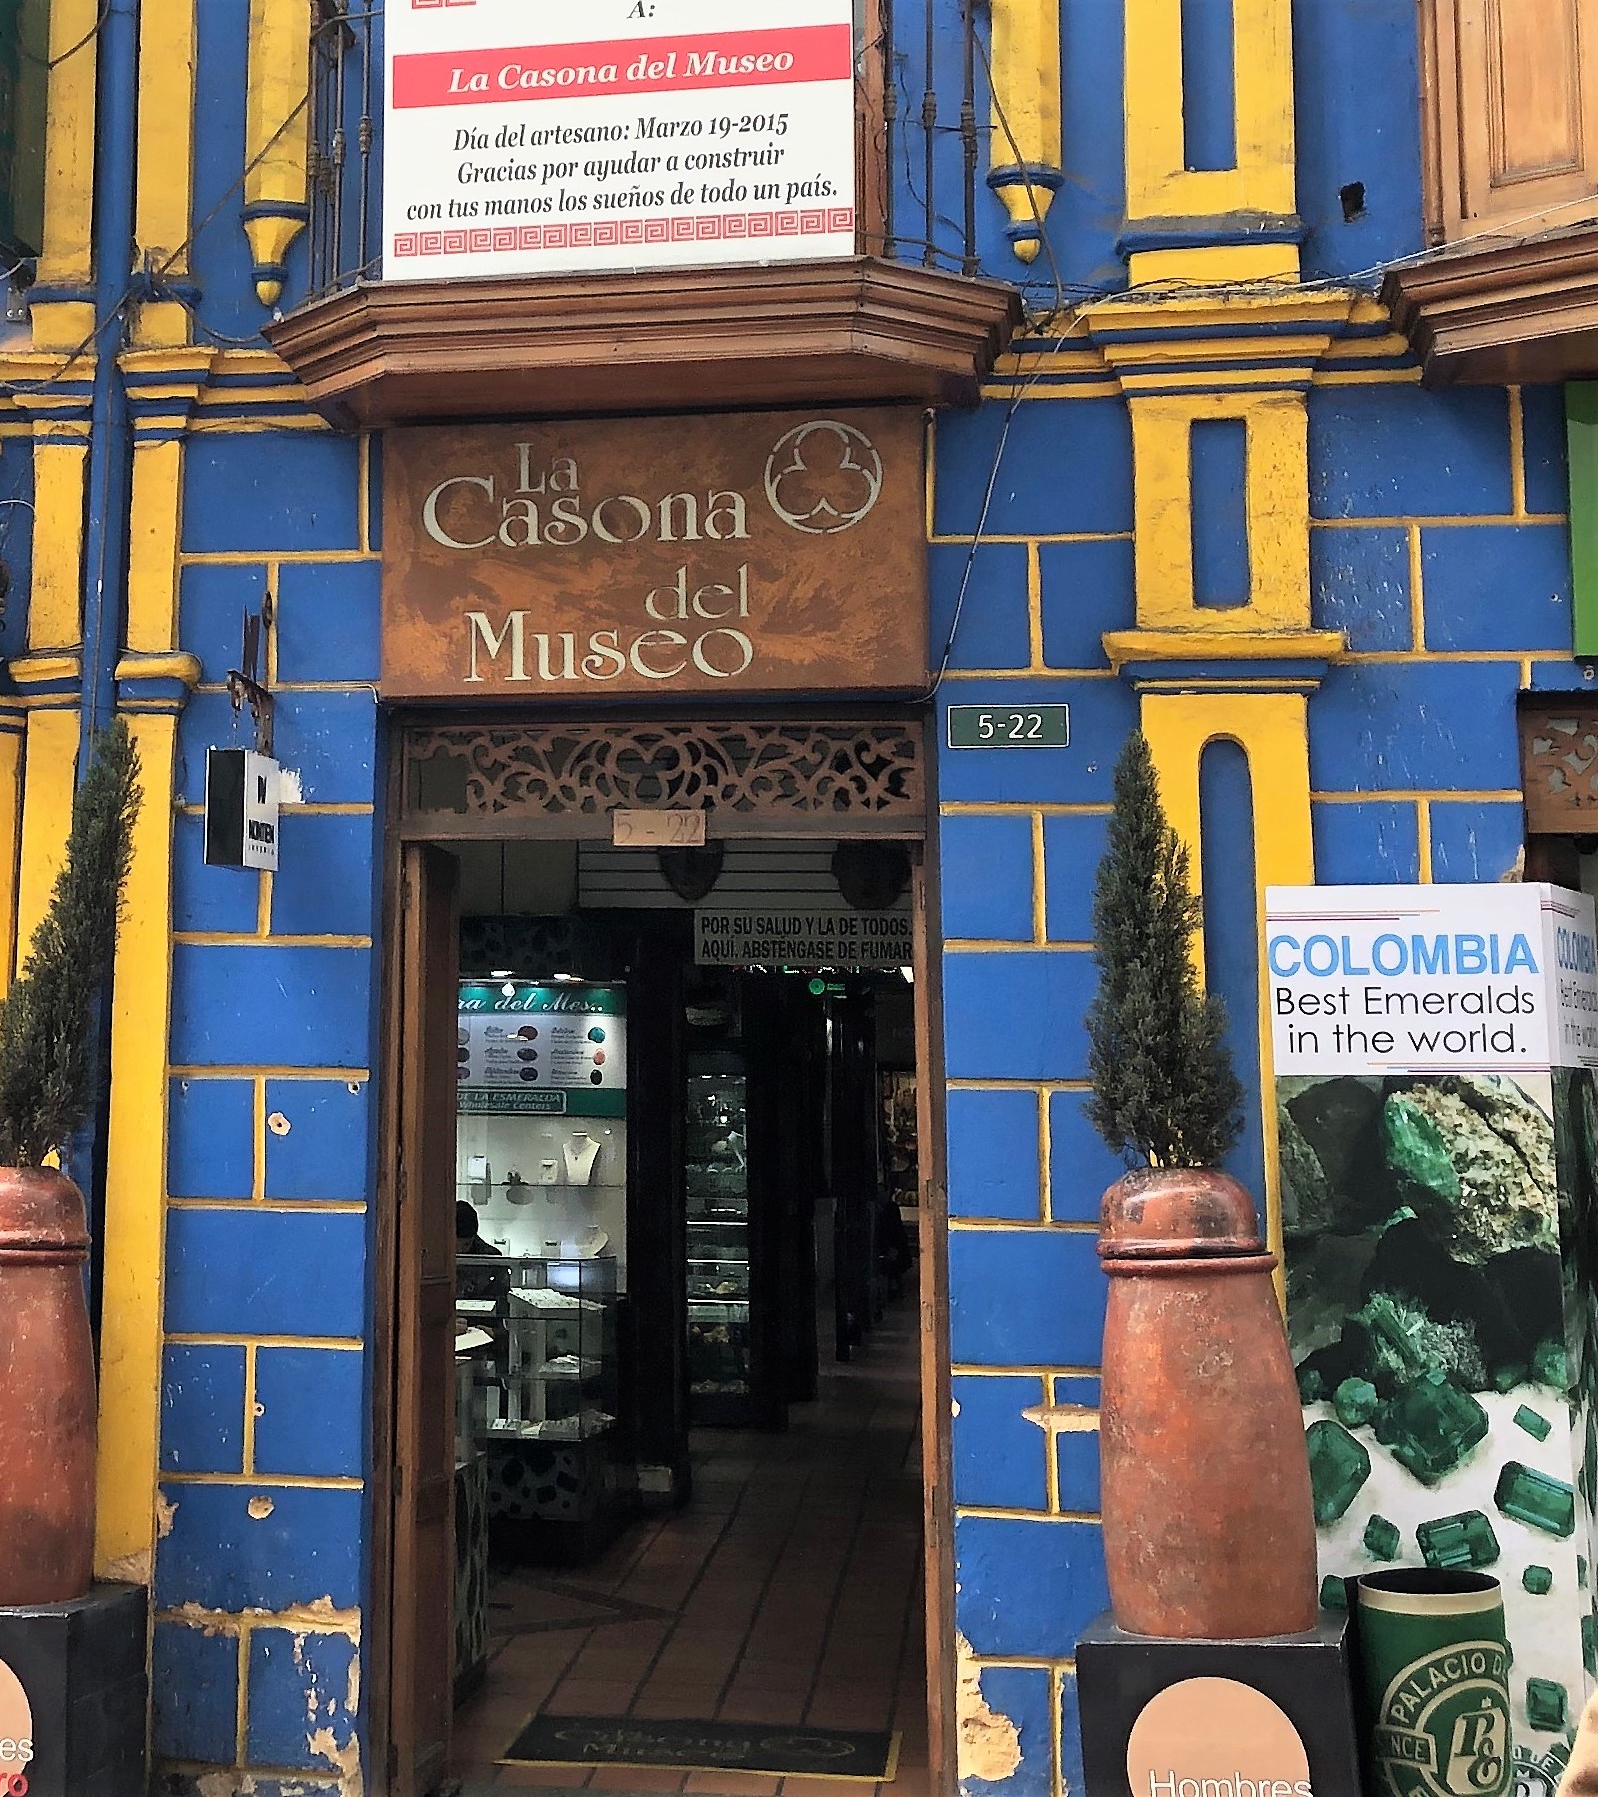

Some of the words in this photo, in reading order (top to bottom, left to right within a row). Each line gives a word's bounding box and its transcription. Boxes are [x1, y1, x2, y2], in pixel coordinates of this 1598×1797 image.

[626, 0, 656, 19] A:
[447, 67, 490, 94] La
[497, 62, 619, 91] Casona
[625, 51, 678, 83] del
[683, 49, 795, 77] Museo
[453, 126, 489, 151] Día
[494, 123, 526, 149] del
[530, 123, 630, 147] artesano:
[634, 116, 703, 140] Marzo
[708, 113, 789, 139] 19-2015
[457, 158, 537, 184] Gracias
[540, 161, 579, 185] por
[583, 150, 661, 182] ayudar
[666, 158, 679, 172] a
[684, 142, 785, 171] construir
[406, 203, 442, 221] con
[448, 198, 479, 218] tus
[484, 196, 553, 217] manos
[558, 188, 587, 212] los
[592, 184, 665, 210] sueños
[670, 181, 695, 206] de
[700, 178, 748, 204] todo
[753, 180, 782, 200] un
[786, 173, 838, 205] país.
[515, 442, 579, 495] La
[422, 474, 751, 550] Casona
[644, 563, 749, 621] del
[464, 609, 754, 683] Museo
[977, 712, 1044, 741] 5-22
[701, 916, 730, 936] POR
[733, 916, 752, 936] SU
[756, 916, 802, 937] SALUD
[805, 916, 815, 936] Y
[818, 916, 835, 936] LA
[839, 916, 857, 936] DE
[838, 940, 856, 960] DE
[860, 940, 914, 960] FUMAR
[1268, 932, 1540, 978] COLOMBIA
[494, 992, 537, 1012] del
[1275, 986, 1351, 1016] Best
[1363, 984, 1536, 1015] Emeralds
[1288, 1023, 1319, 1054] in
[1332, 1023, 1395, 1054] the
[1407, 1023, 1527, 1054] world.
[493, 1092, 561, 1103] ESMERALDA
[1390, 1652, 1487, 1724] PALACIO
[1148, 1769, 1313, 1797] Hombres
